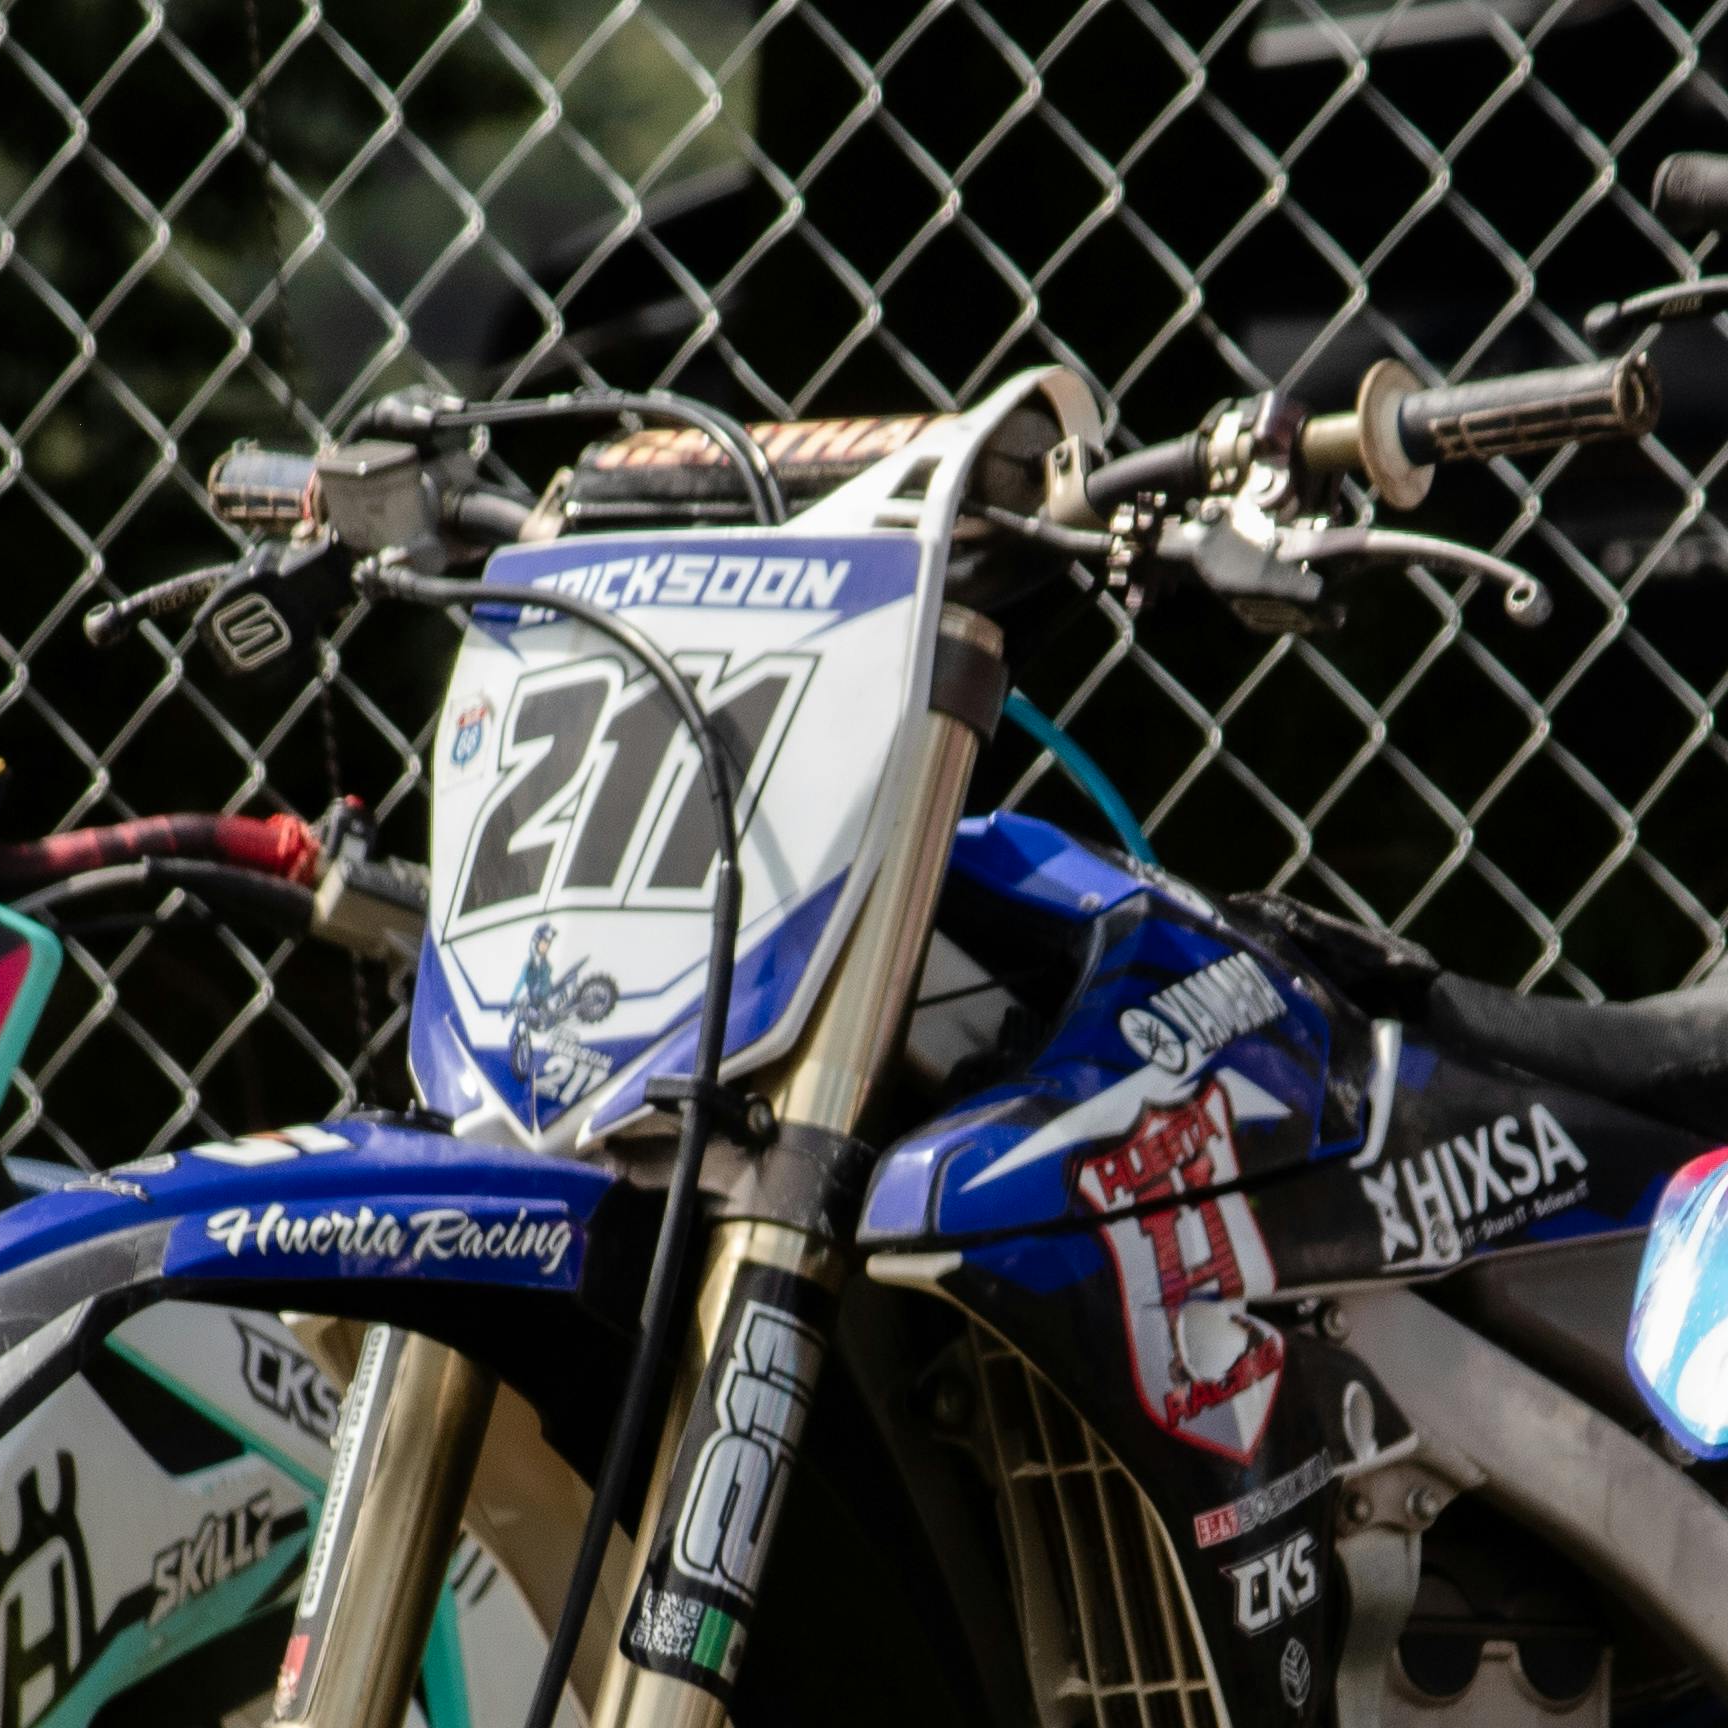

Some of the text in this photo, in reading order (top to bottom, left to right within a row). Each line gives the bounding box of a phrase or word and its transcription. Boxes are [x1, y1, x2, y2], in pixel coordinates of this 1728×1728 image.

[457, 660, 817, 920] 211
[1400, 1103, 1588, 1230] HIXSA
[207, 1204, 575, 1273] Huerta Racing
[1232, 1532, 1317, 1631] CKS
